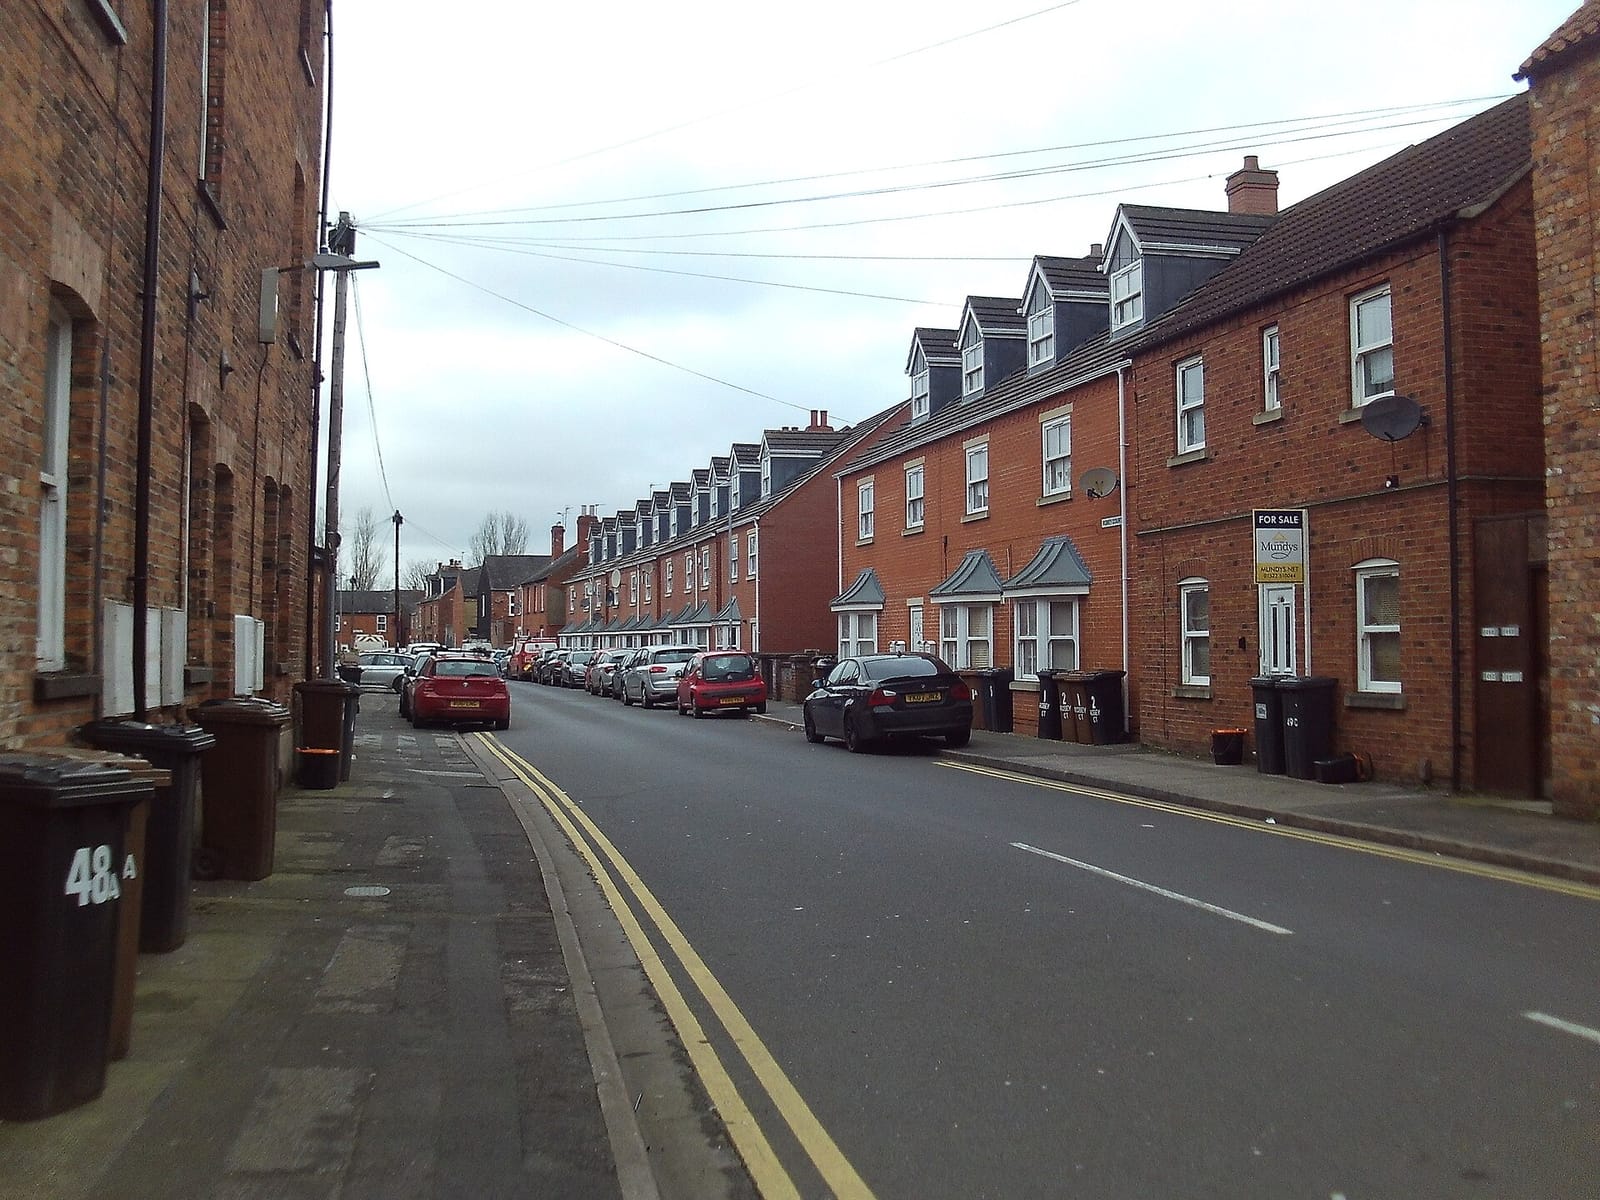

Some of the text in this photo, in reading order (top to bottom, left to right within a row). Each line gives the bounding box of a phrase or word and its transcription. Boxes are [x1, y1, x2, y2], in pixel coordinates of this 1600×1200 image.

[1259, 515, 1299, 524] FOR SALE
[1261, 541, 1298, 554] Mundys
[1061, 692, 1066, 704] 2
[1076, 693, 1081, 706] 1
[1091, 696, 1096, 708] 2
[122, 854, 137, 880] A
